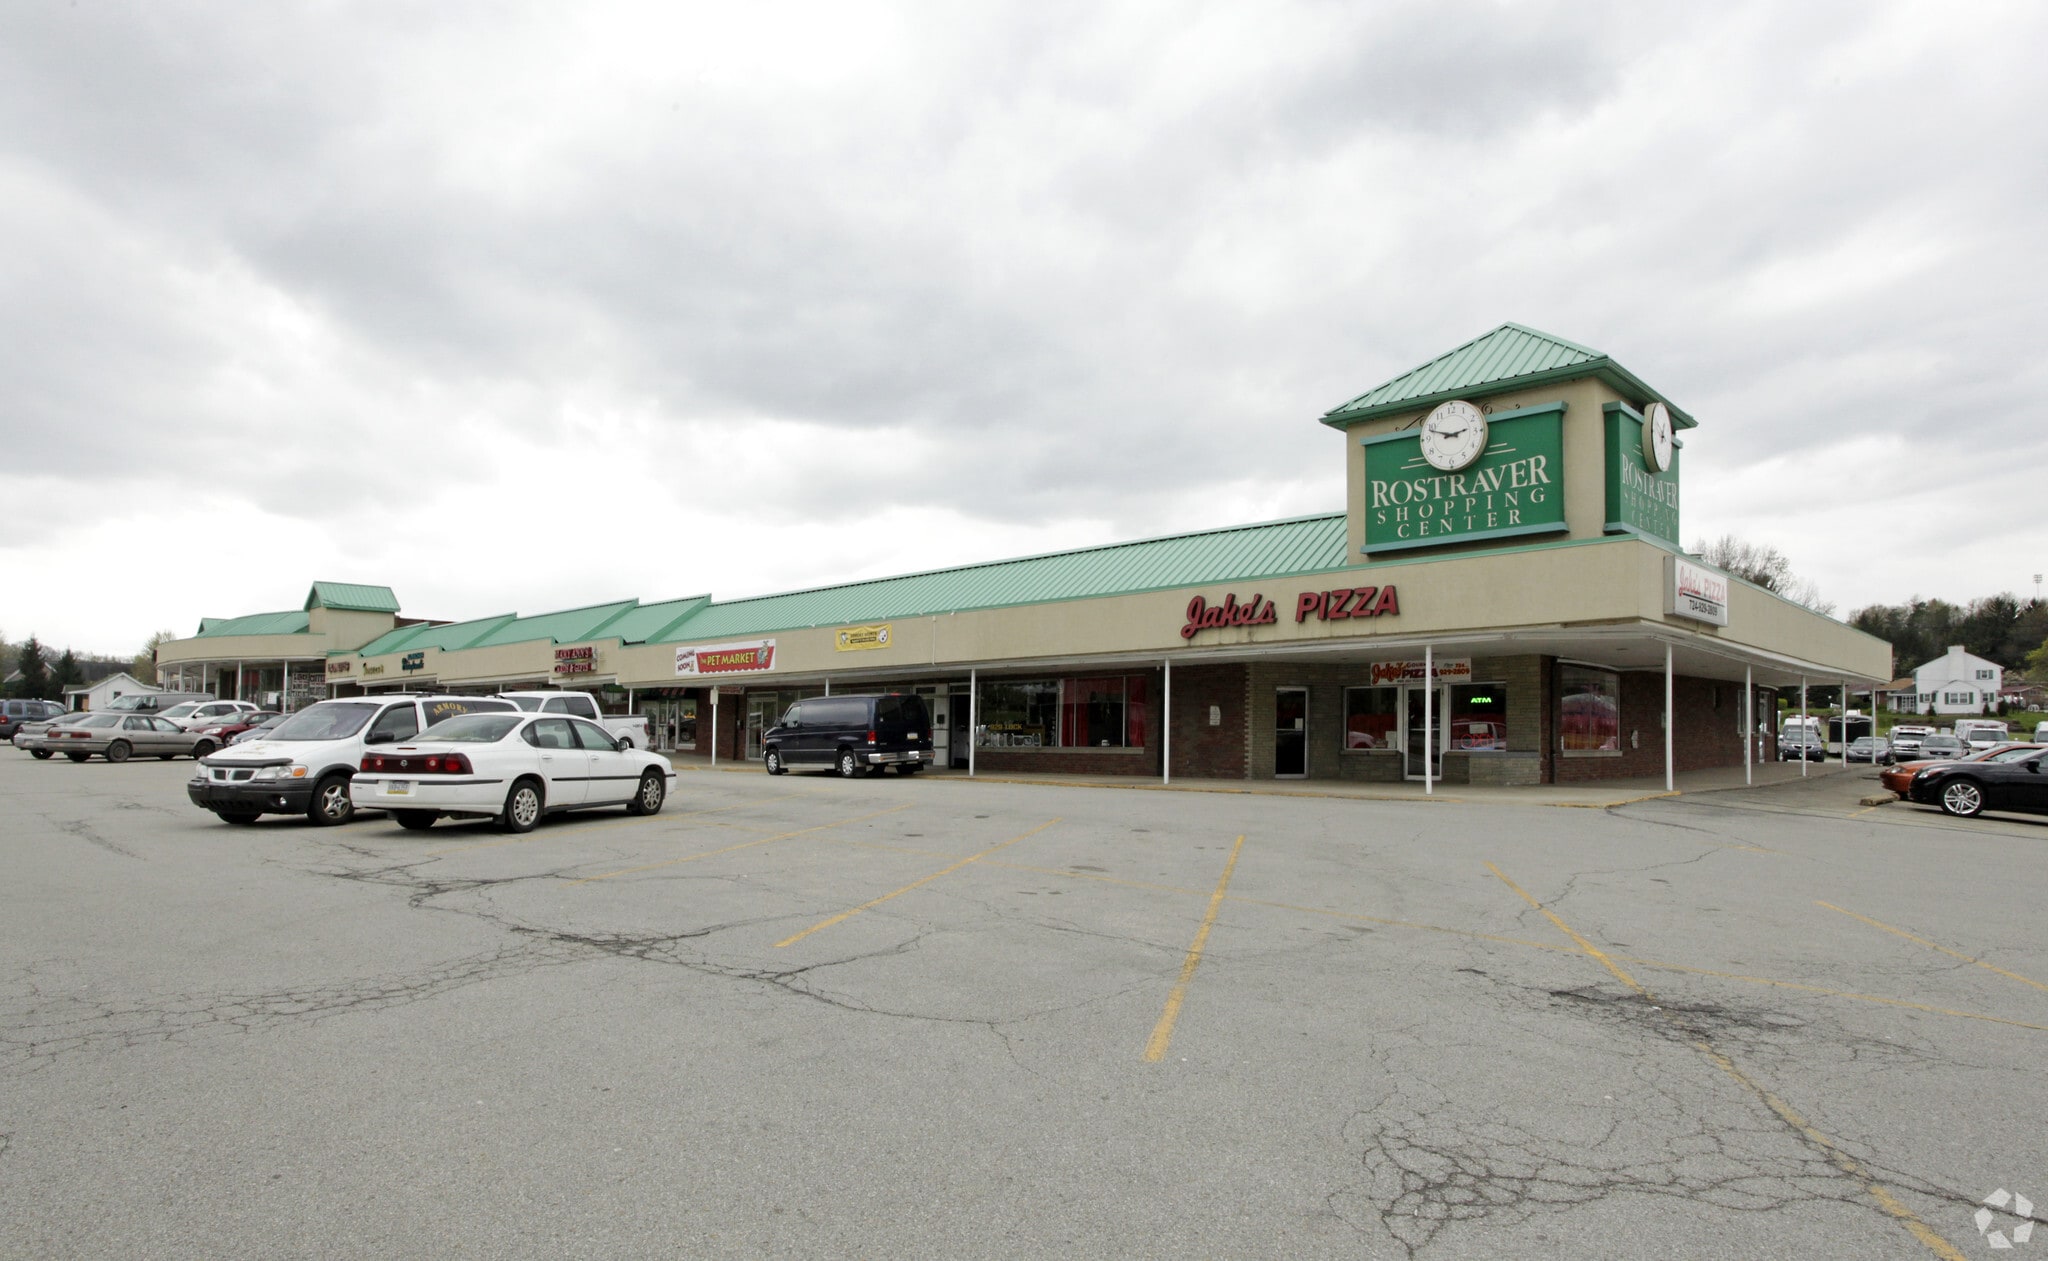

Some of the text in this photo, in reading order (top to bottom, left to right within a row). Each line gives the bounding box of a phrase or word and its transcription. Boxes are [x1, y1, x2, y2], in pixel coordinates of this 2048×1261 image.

[1436, 412, 1443, 420] 11
[1448, 406, 1456, 415] 12
[1371, 454, 1551, 508] ROSTRAVER
[1621, 453, 1678, 511] ROSTRAVER
[1376, 487, 1546, 525] SHOPPING
[1397, 508, 1522, 539] CENTER
[1703, 577, 1726, 602] PIZZA
[1180, 584, 1400, 639] Jake's PIZZA
[707, 655, 720, 666] PET
[721, 652, 755, 665] MARKET
[1470, 696, 1492, 704] ATM
